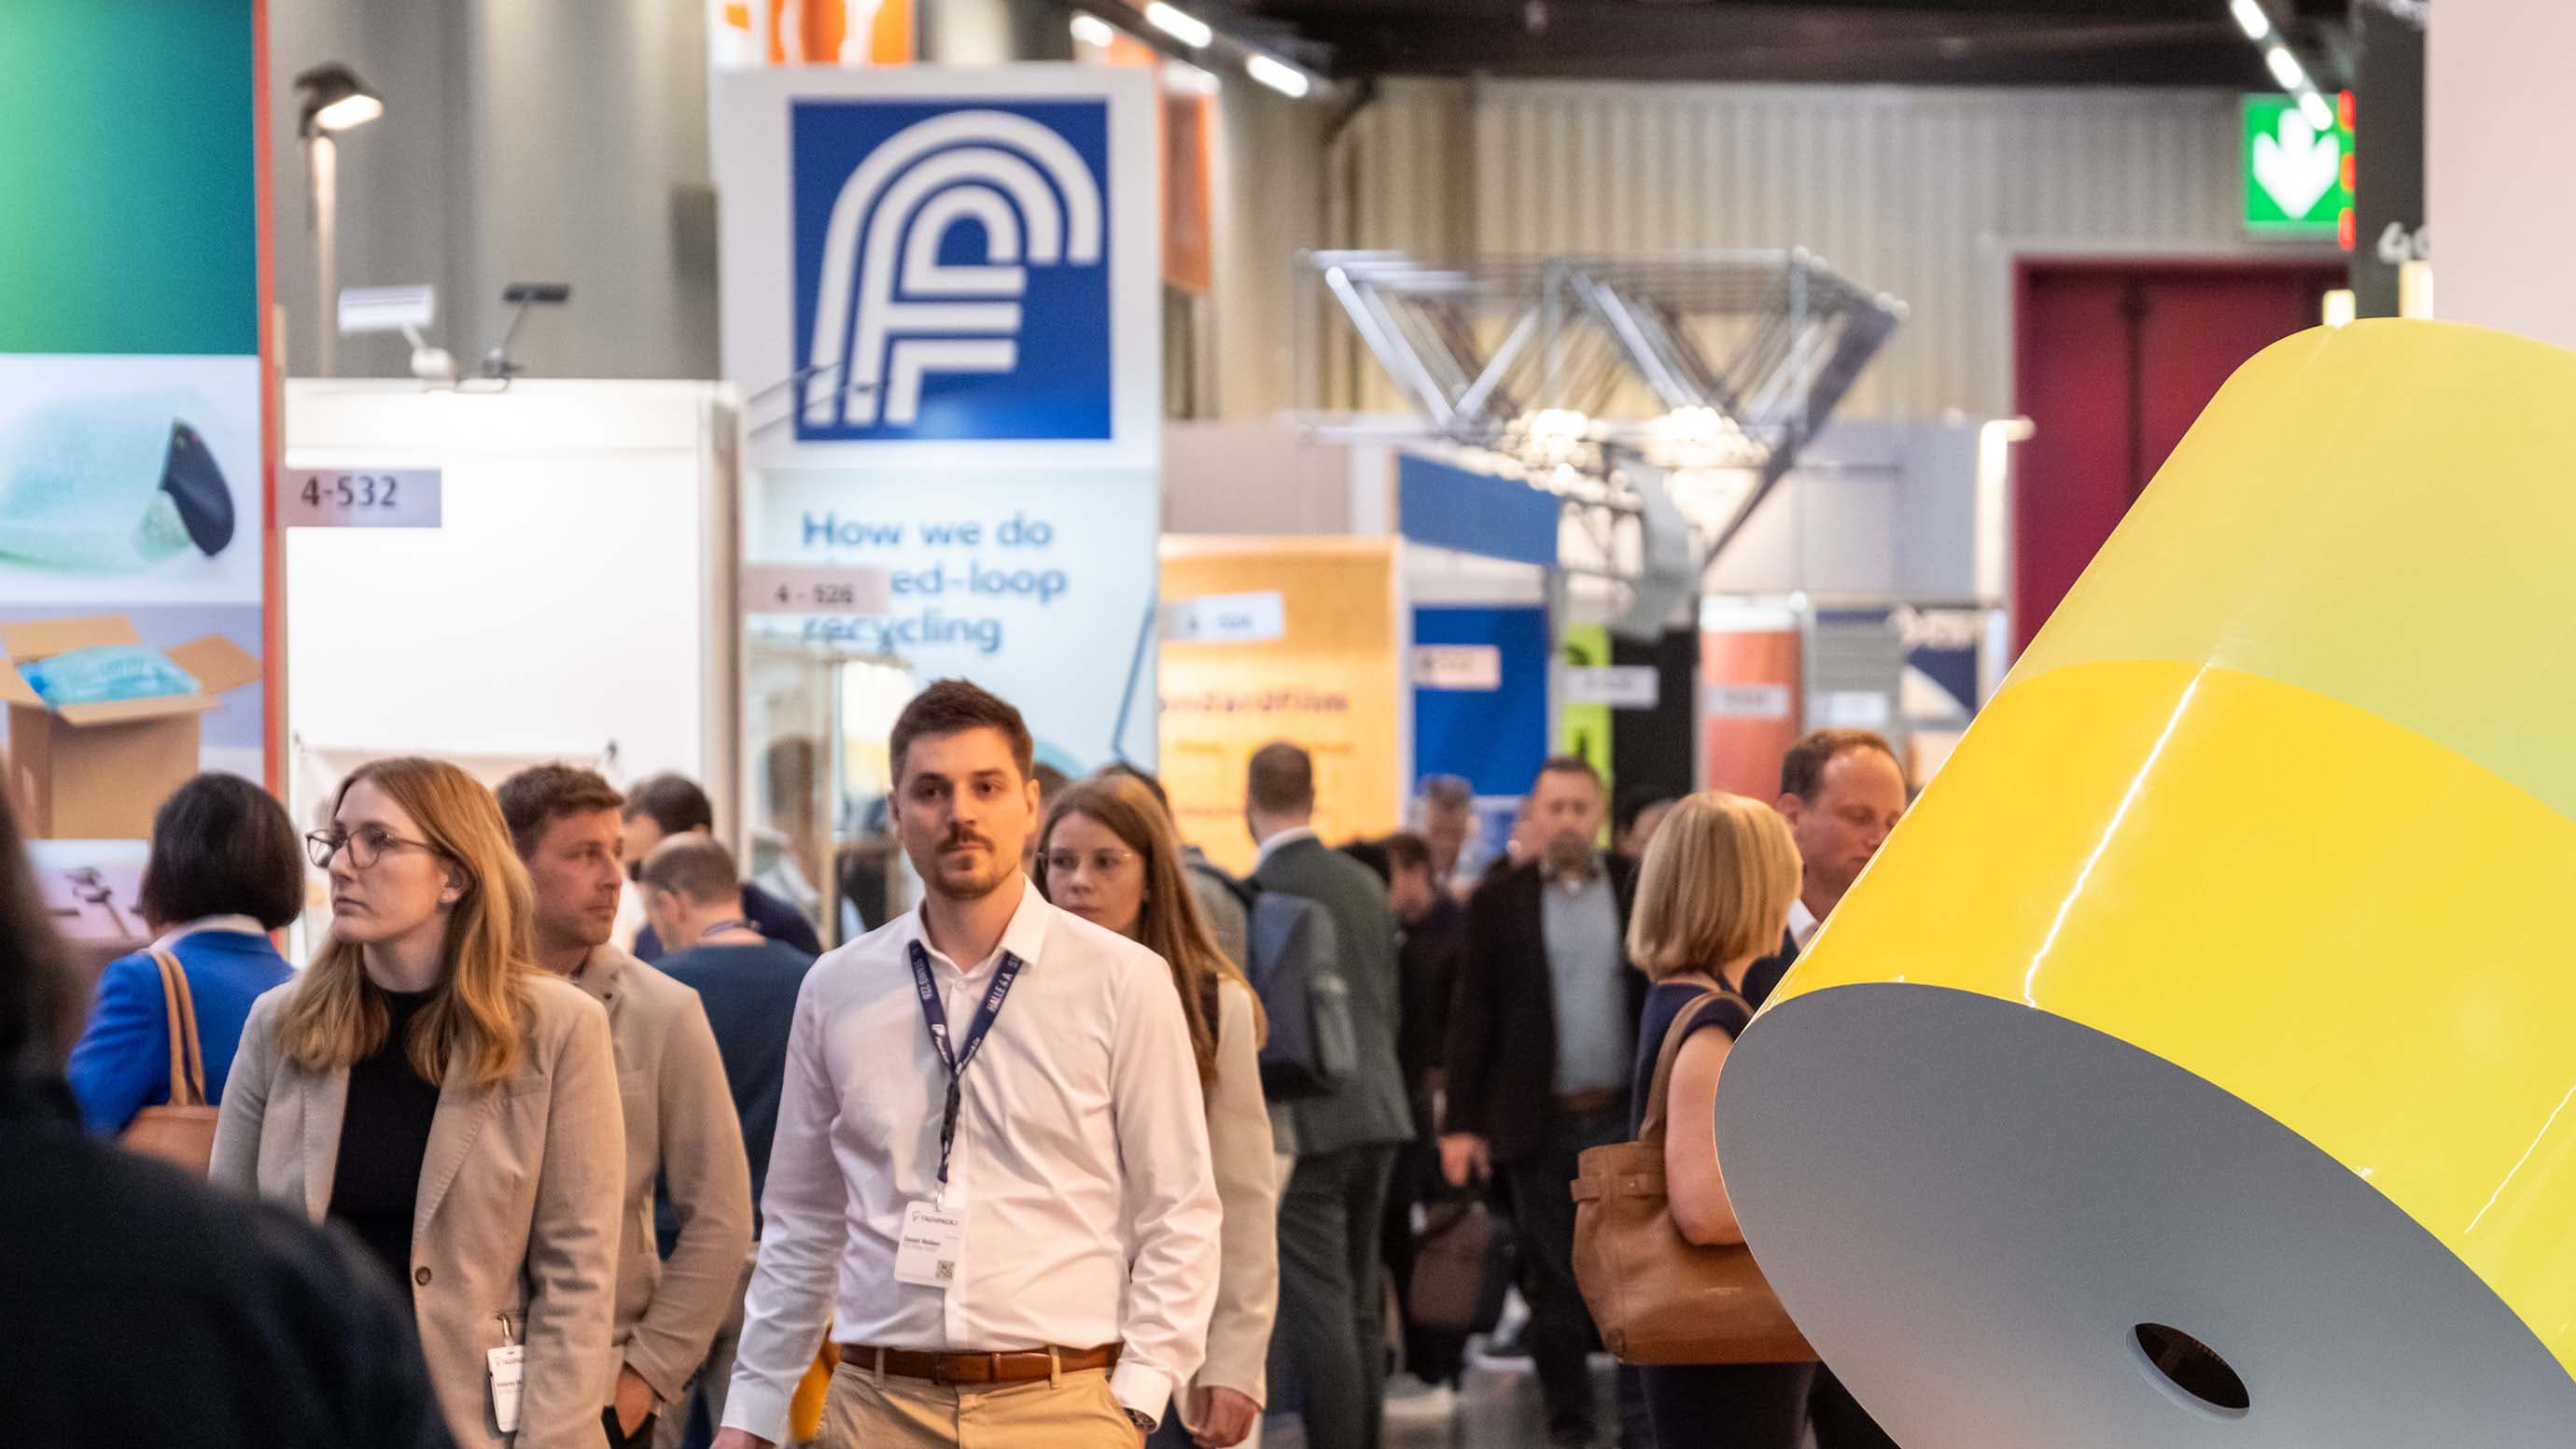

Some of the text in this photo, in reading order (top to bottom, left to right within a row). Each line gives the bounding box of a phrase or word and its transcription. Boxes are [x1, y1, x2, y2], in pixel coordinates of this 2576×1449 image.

[301, 474, 399, 508] 4-532
[801, 511, 1054, 547] How we do
[774, 583, 790, 605] 4
[812, 583, 854, 605] 526
[889, 559, 1069, 607] ed-loop
[802, 608, 1004, 654] recycling
[987, 985, 1005, 1012] HALLE
